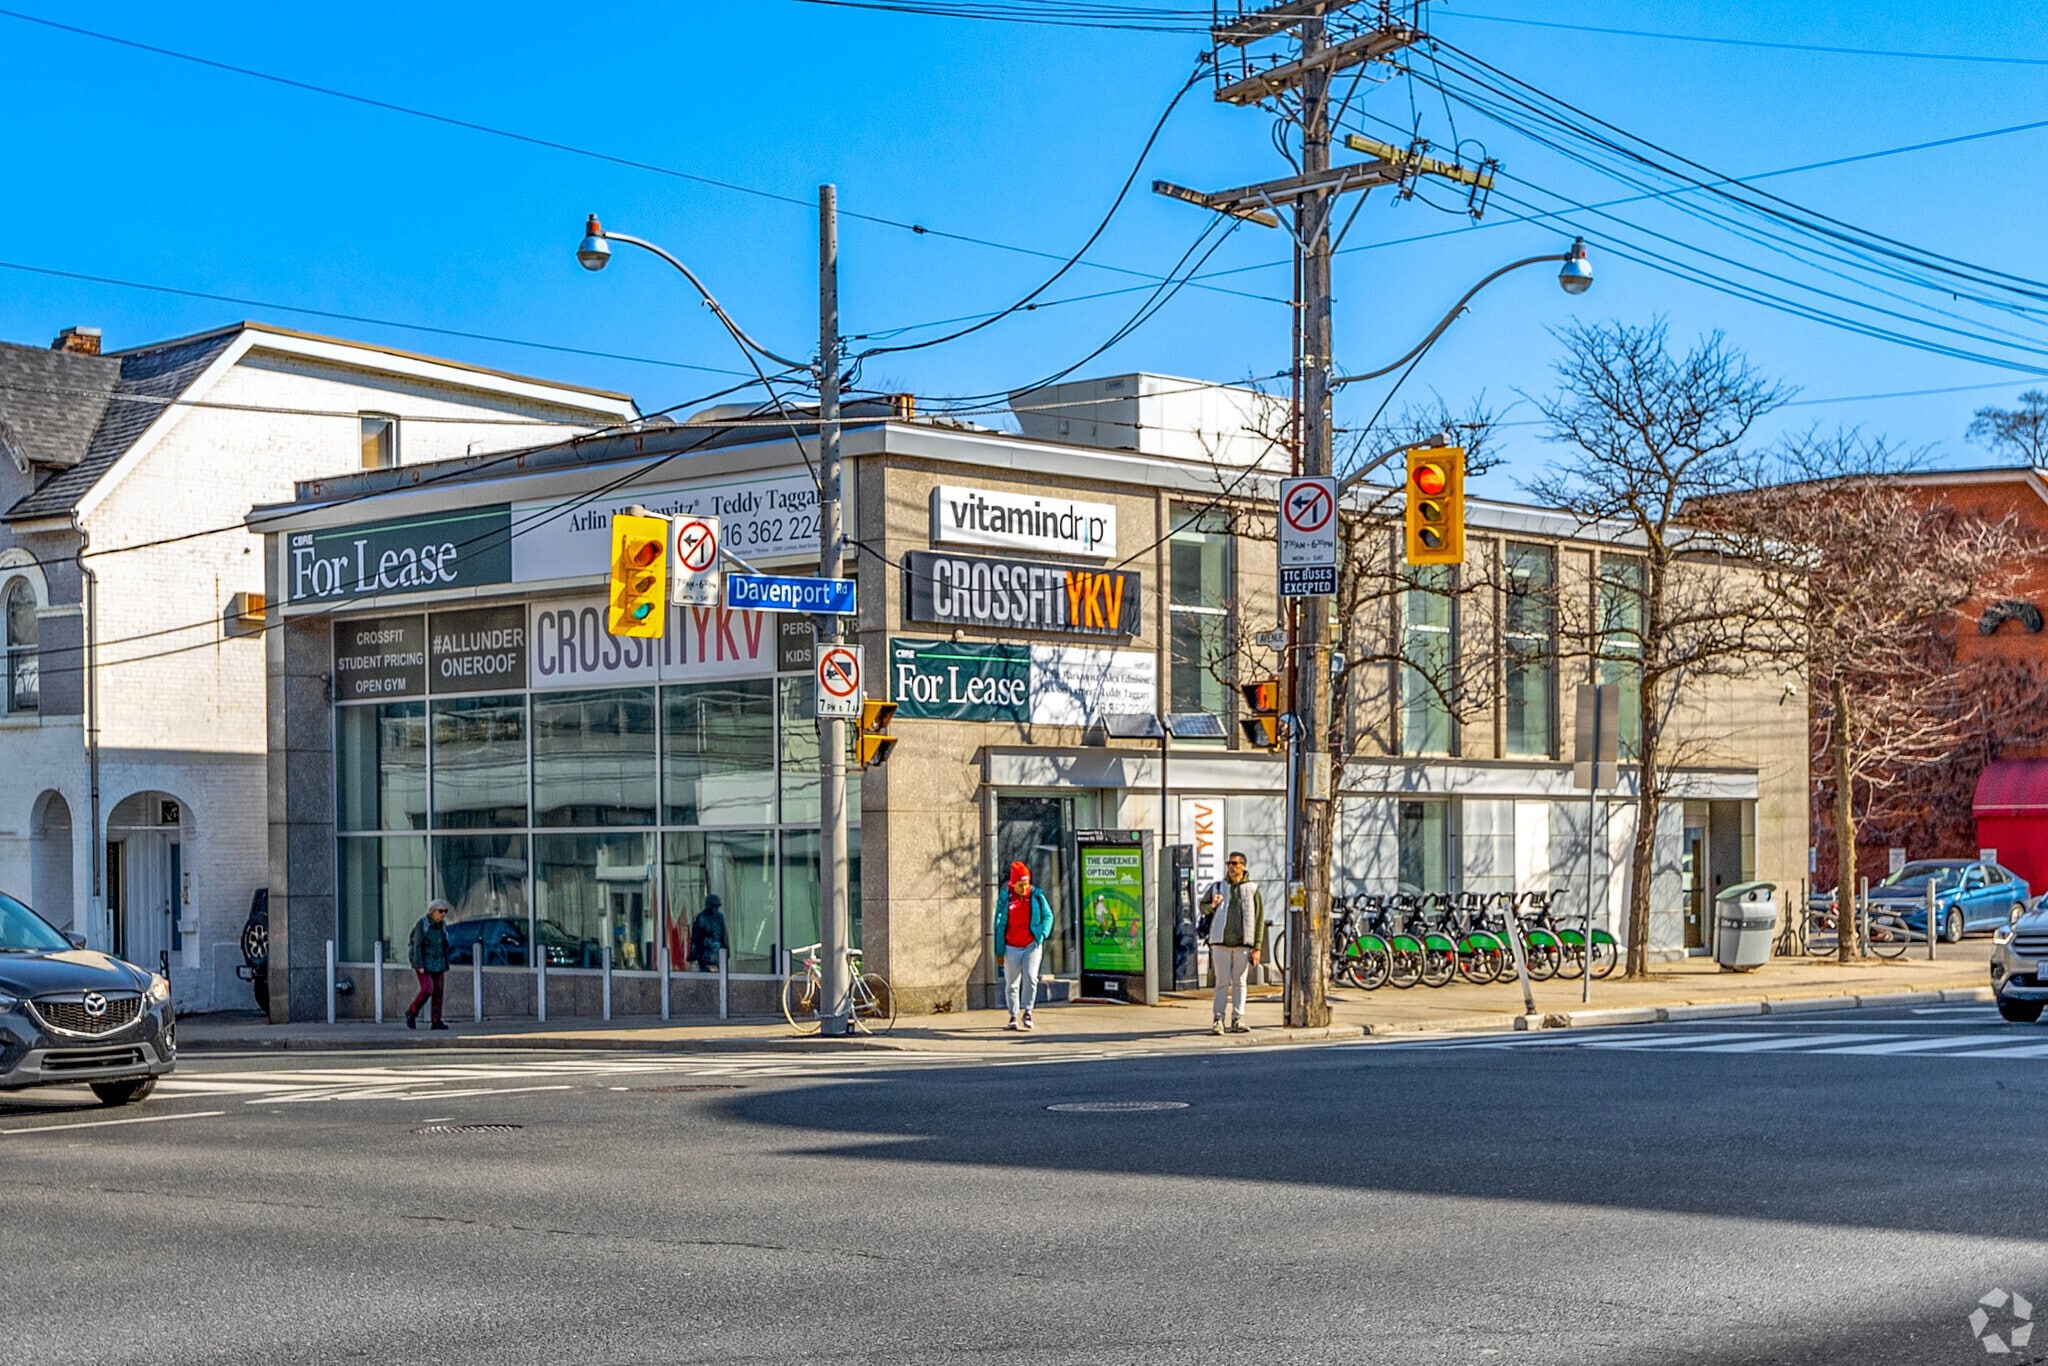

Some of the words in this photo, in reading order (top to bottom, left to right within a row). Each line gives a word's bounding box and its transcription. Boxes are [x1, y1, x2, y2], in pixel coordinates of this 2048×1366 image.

[569, 508, 607, 533] Arlin
[711, 492, 762, 516] Teddy
[765, 488, 820, 513] Taggar
[722, 524, 742, 547] 16
[748, 519, 783, 544] 362
[789, 515, 821, 540] 224
[292, 547, 348, 600] For
[354, 540, 458, 591] Lease
[1283, 571, 1300, 581] TTC
[1302, 569, 1332, 581] BUSES
[736, 578, 830, 608] Davenport
[836, 583, 848, 595] Rd
[1285, 582, 1331, 593] EXCEPTED
[356, 629, 404, 645] CROSSFIT
[782, 621, 813, 636] PERS
[432, 627, 525, 655] #ALLUNDER
[338, 655, 382, 672] STUDENT
[384, 652, 424, 668] PRICING
[440, 653, 517, 677] ONEROOF
[785, 649, 812, 663] KIDS
[355, 680, 382, 693] OPEN
[383, 678, 407, 693] GYM
[896, 663, 945, 704] For
[947, 665, 1026, 706] Lease
[1087, 857, 1101, 865] THE
[1102, 857, 1138, 865] GREENER
[1087, 868, 1115, 877] OPTION
